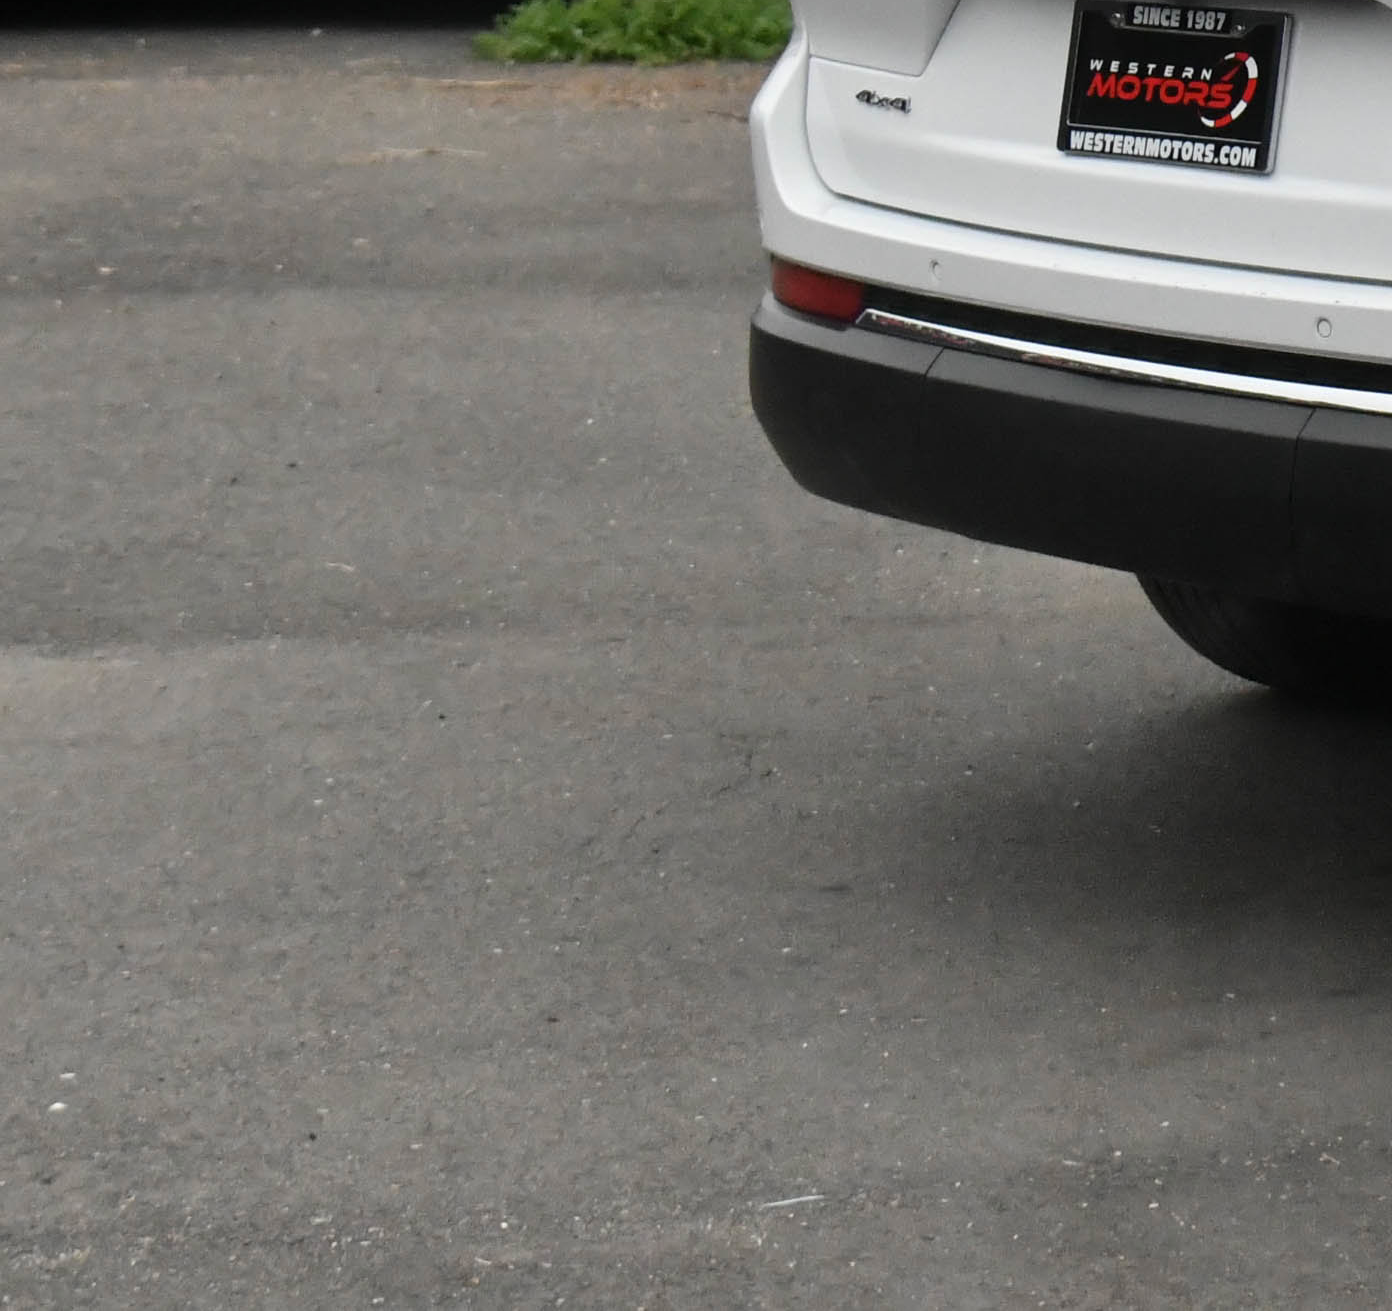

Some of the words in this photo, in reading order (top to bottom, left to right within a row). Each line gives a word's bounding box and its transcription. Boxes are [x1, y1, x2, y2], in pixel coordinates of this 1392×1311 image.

[1132, 5, 1181, 28] SINCE
[1186, 9, 1227, 31] 1987
[1089, 59, 1213, 80] WESTERN
[1086, 73, 1234, 110] MOTORS
[1069, 129, 1258, 168] WESTERNMOTORS.COM
